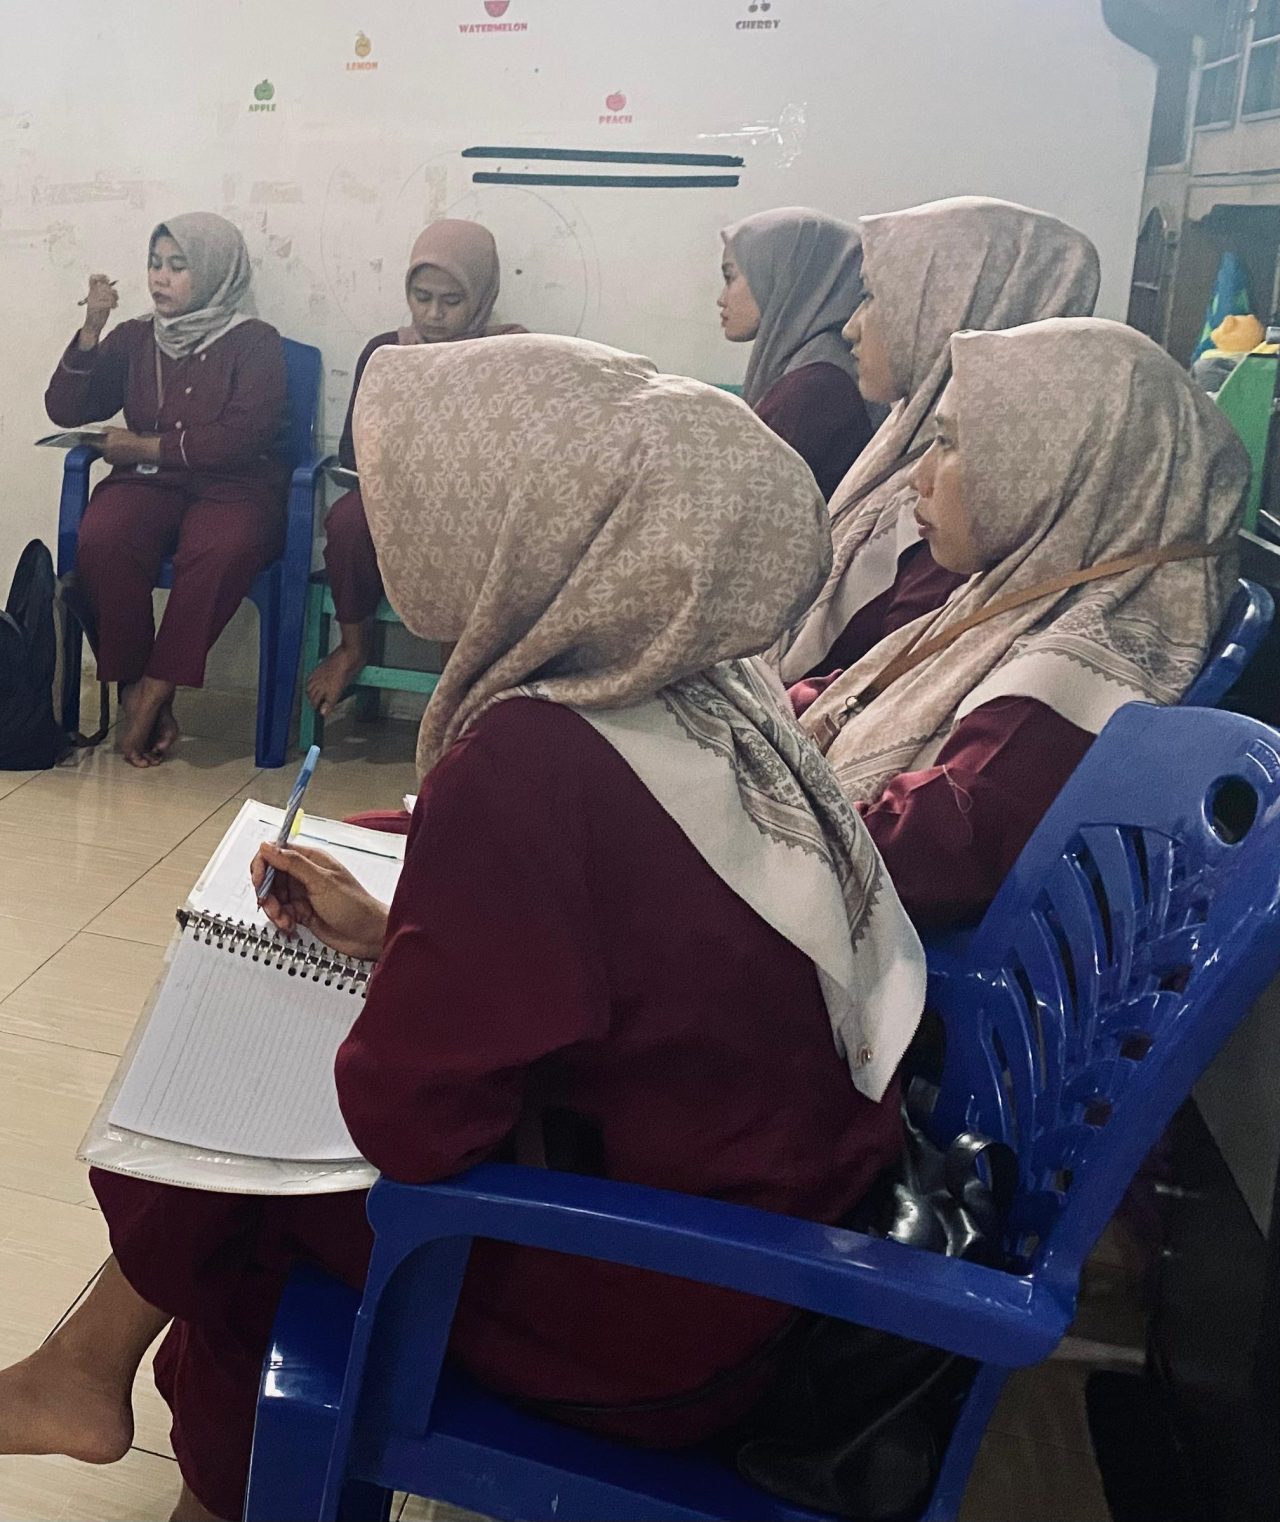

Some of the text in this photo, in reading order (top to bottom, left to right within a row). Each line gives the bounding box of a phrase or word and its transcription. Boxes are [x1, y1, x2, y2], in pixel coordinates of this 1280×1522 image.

[459, 23, 528, 33] WATERMELON
[735, 19, 781, 29] CHERRY
[346, 62, 378, 71] LEMON
[248, 103, 276, 112] APPLE
[599, 115, 632, 124] PEACH
